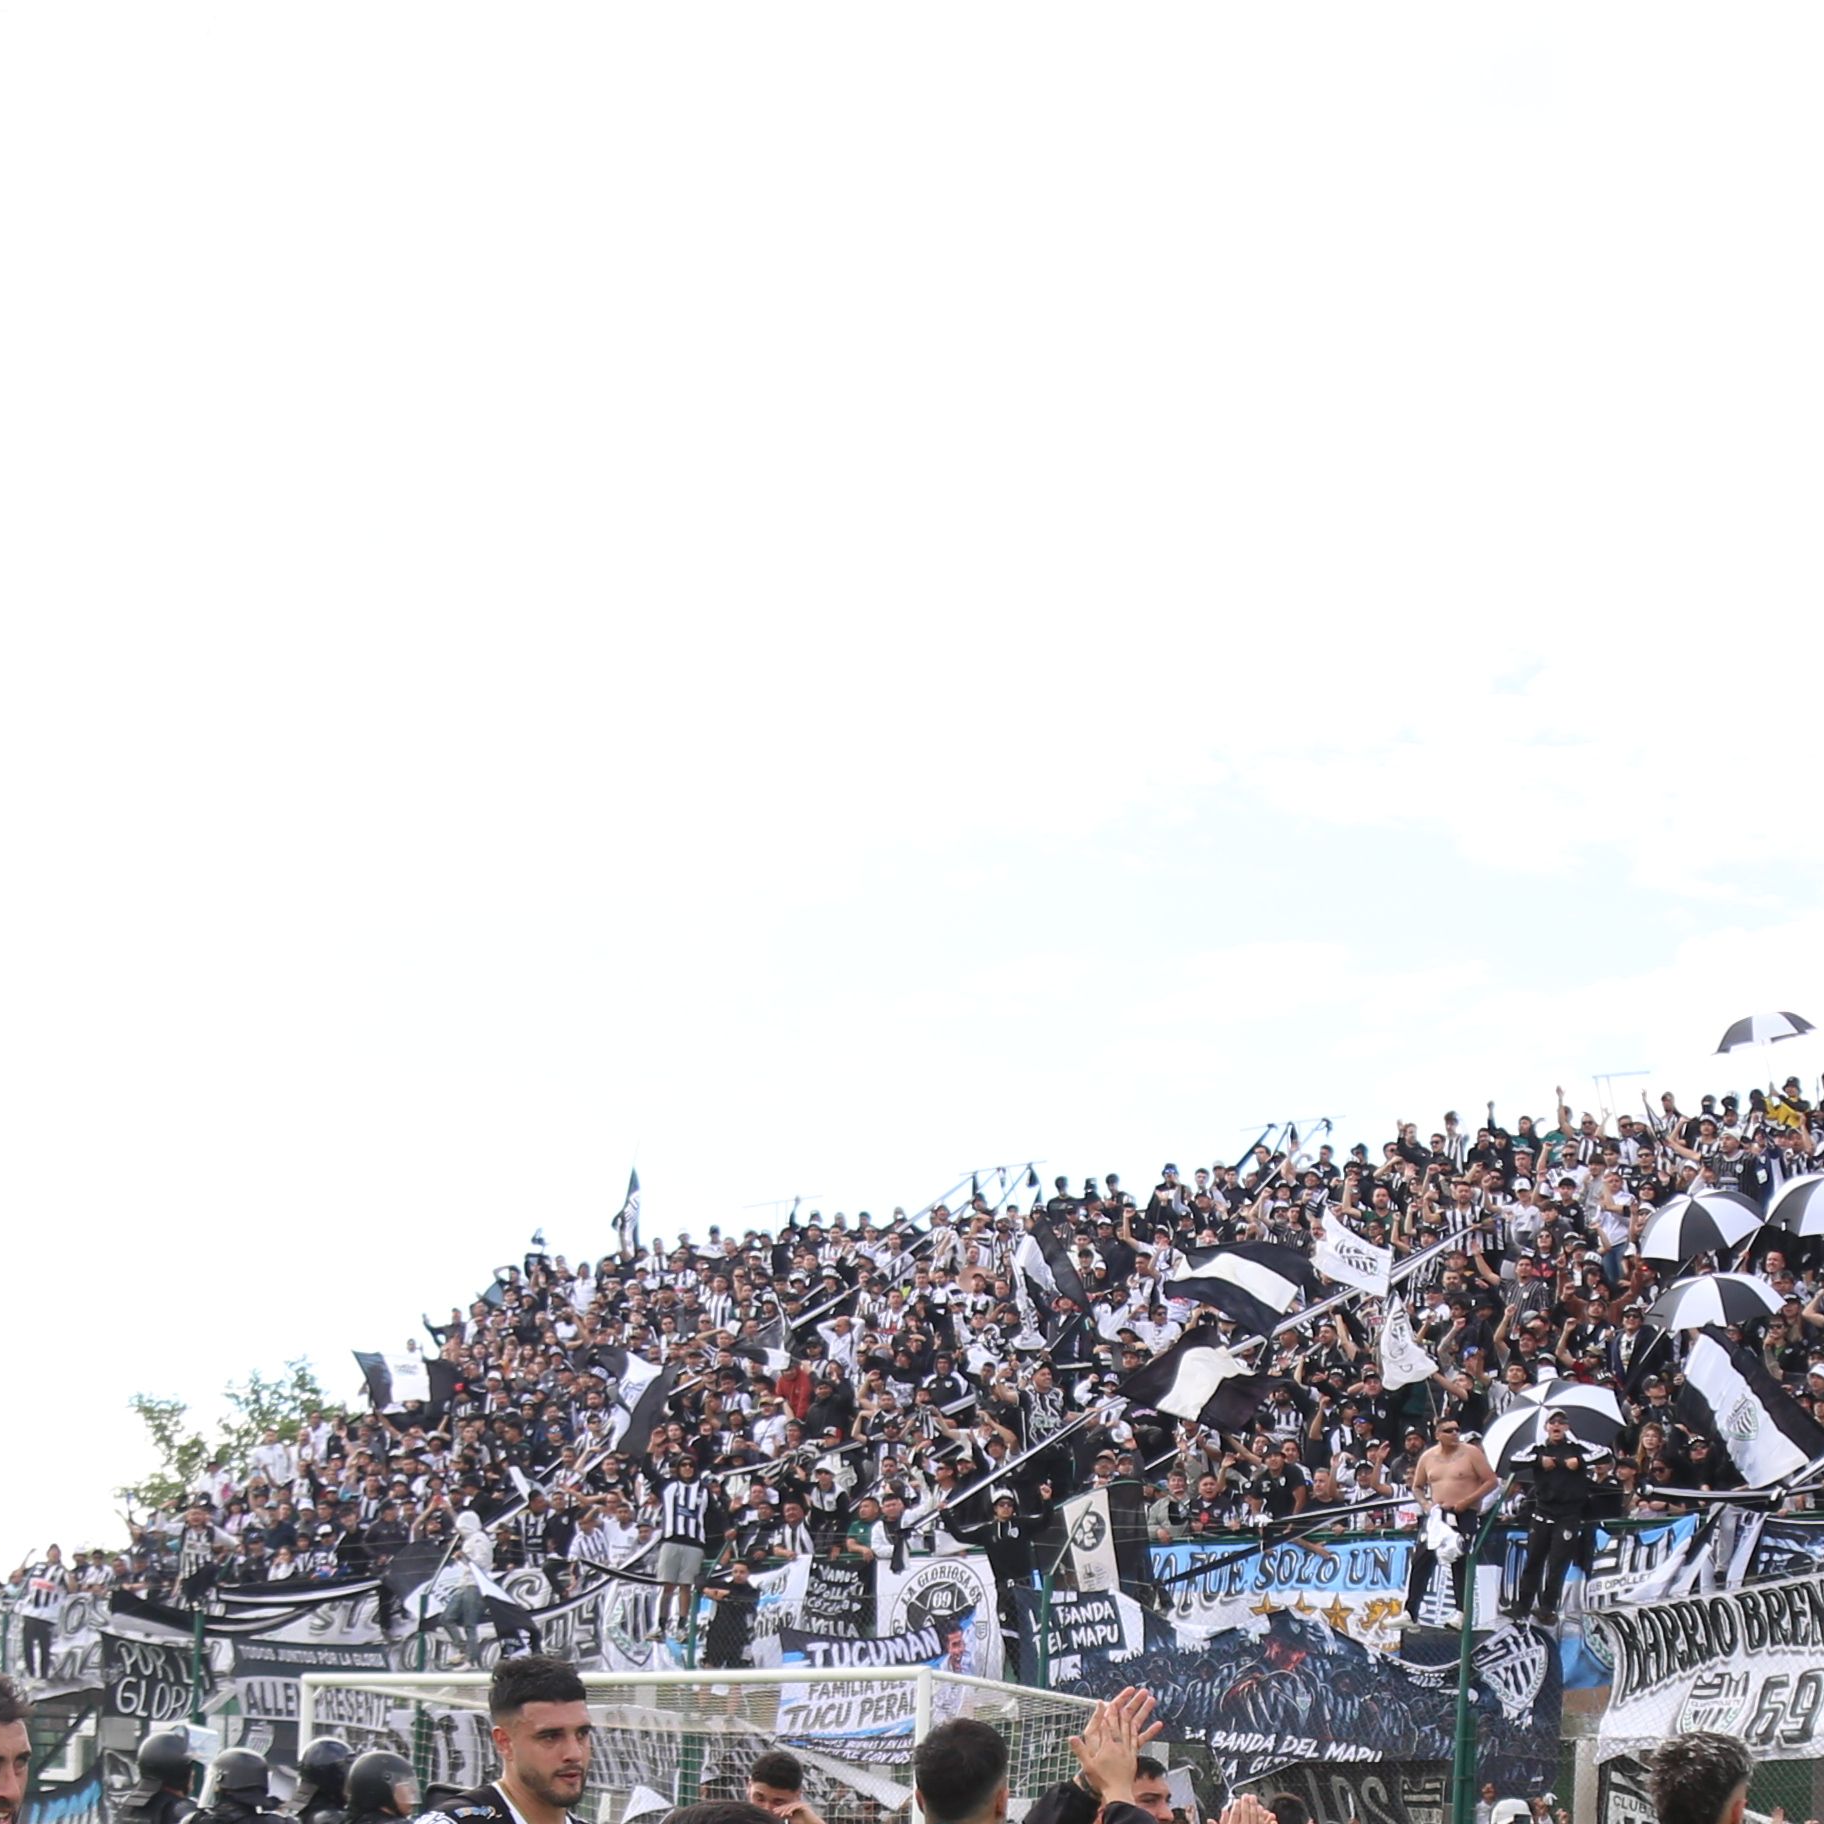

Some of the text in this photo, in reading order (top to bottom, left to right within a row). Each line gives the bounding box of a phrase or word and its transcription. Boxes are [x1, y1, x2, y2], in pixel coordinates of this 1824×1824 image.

[1255, 1545, 1340, 1594] SOLO
[807, 1626, 943, 1667] TUCUMAN
[783, 1703, 850, 1732] TUCU
[1210, 1730, 1277, 1754] BANDA
[1279, 1735, 1320, 1759] DEL
